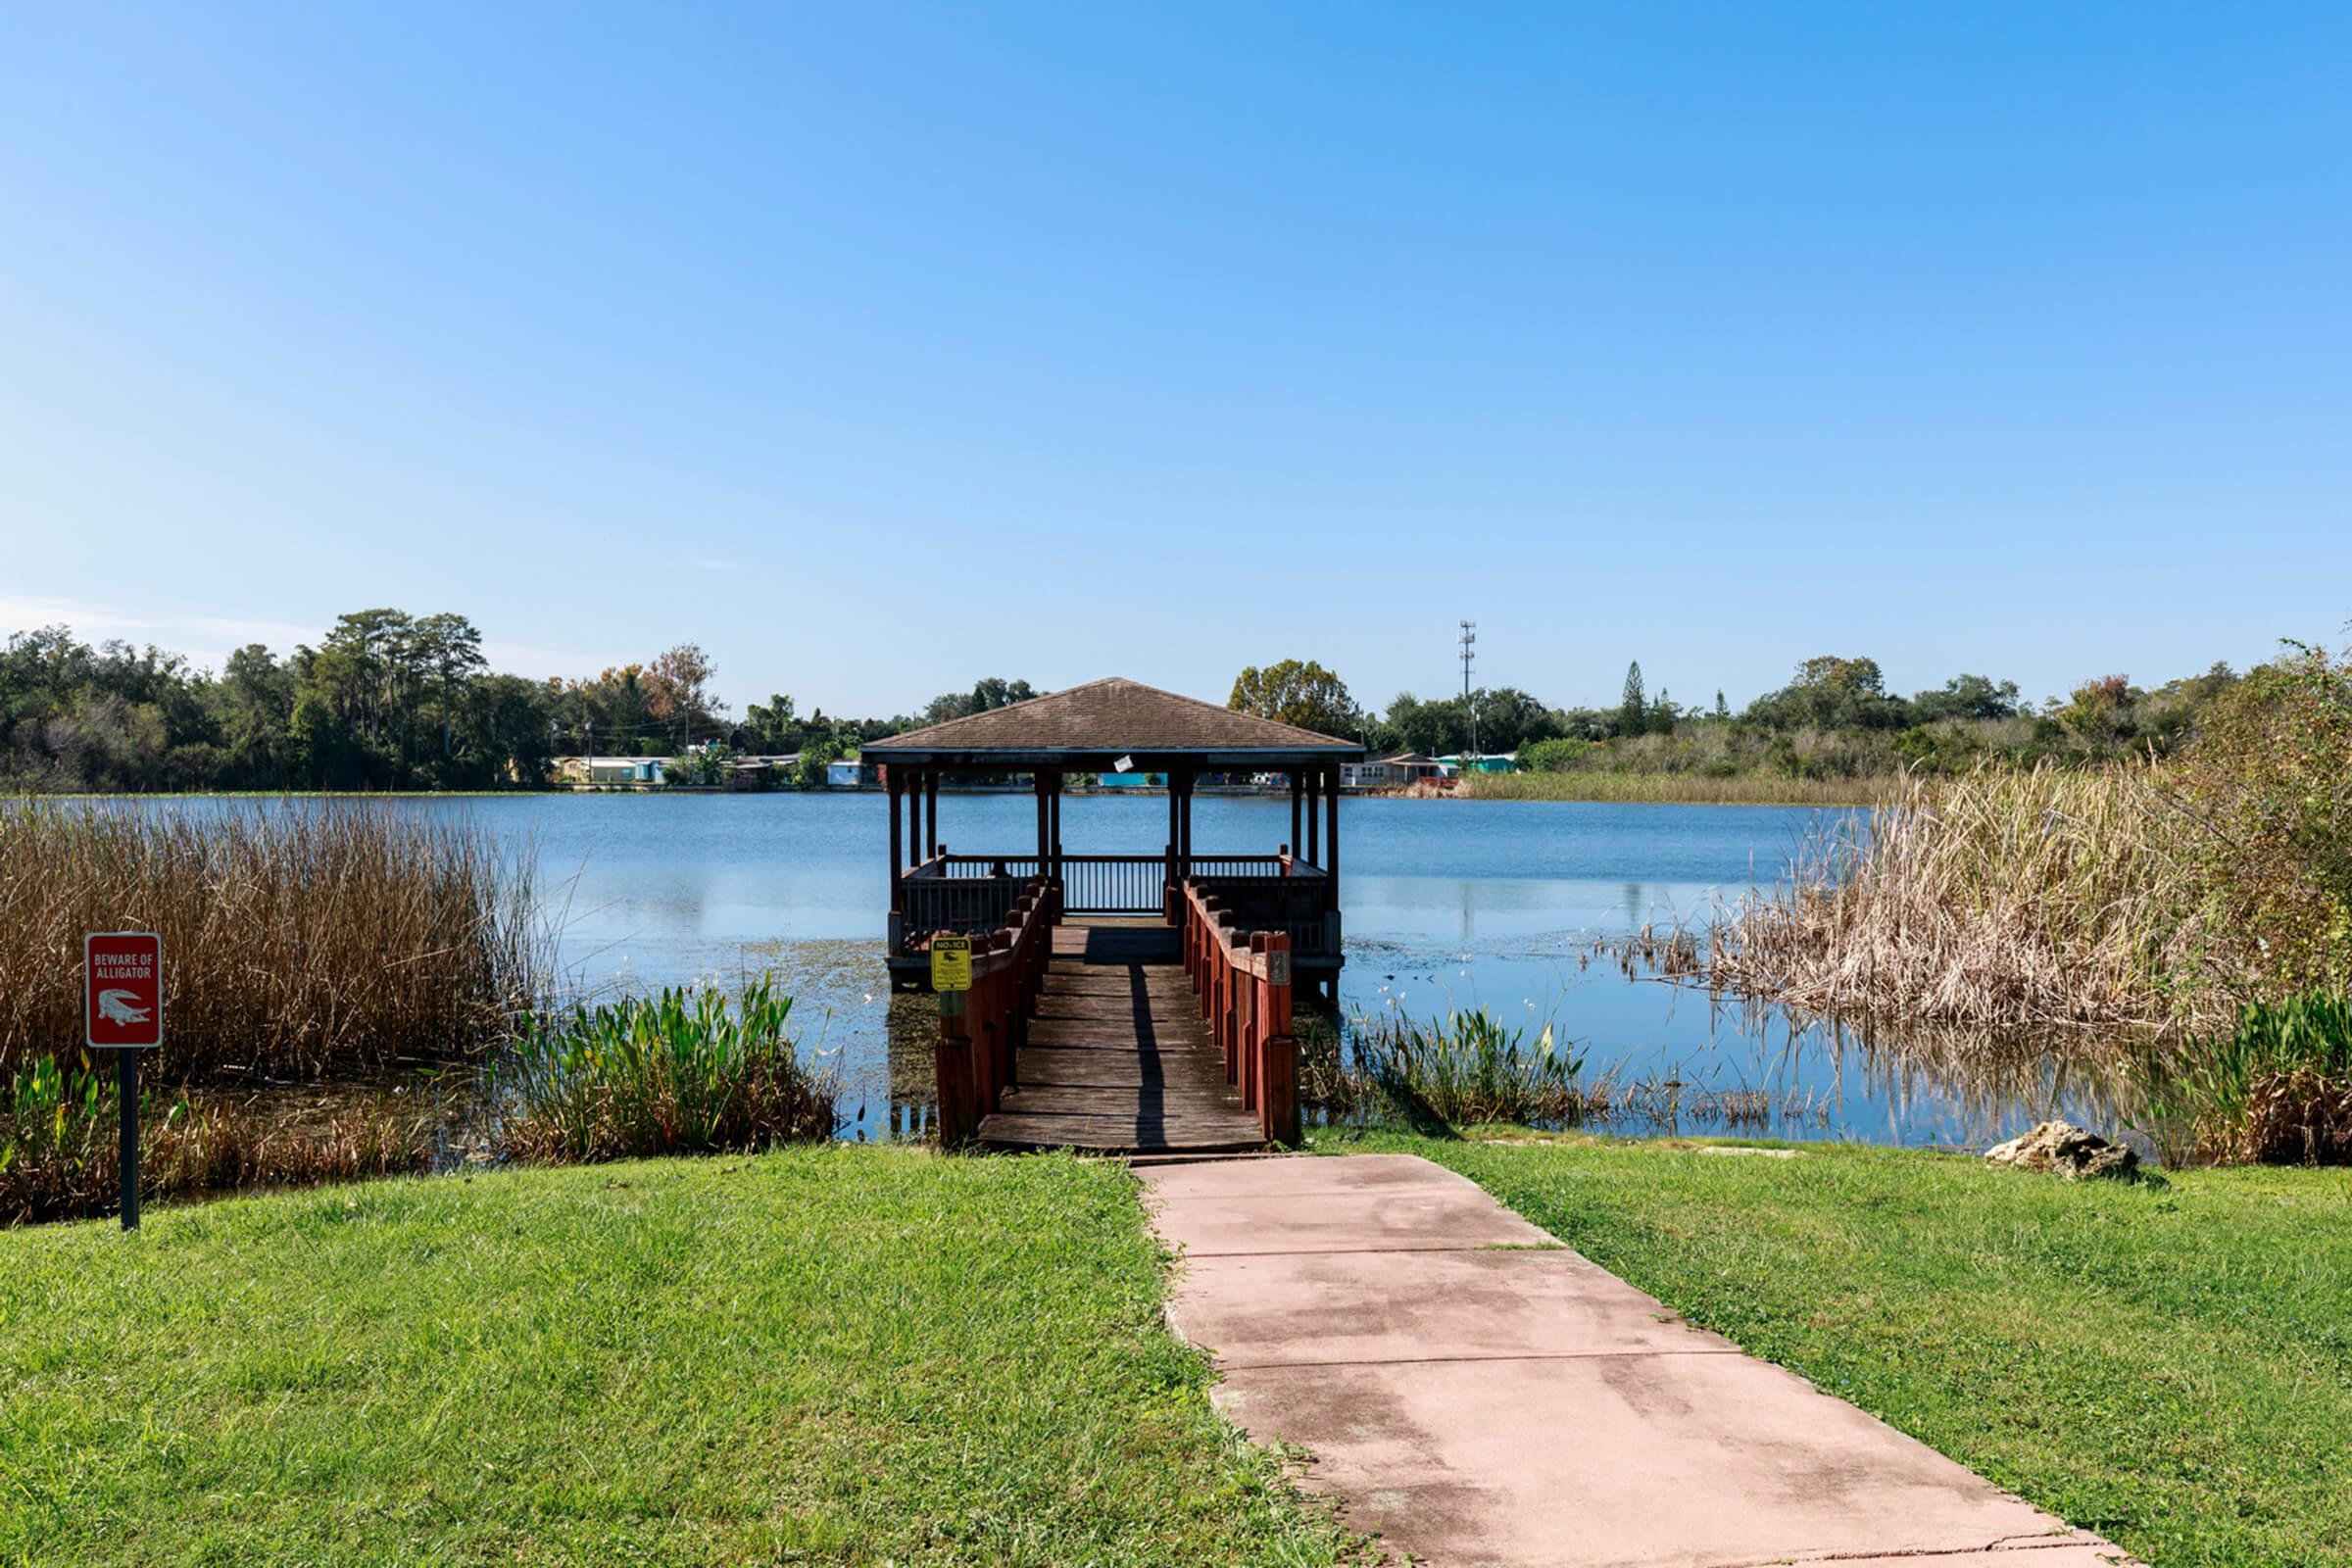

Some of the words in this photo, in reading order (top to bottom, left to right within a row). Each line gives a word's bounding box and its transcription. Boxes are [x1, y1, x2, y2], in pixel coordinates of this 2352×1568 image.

[94, 954, 137, 965] BEWARE
[140, 954, 153, 965] OF
[96, 966, 151, 979] ALLIGATOR
